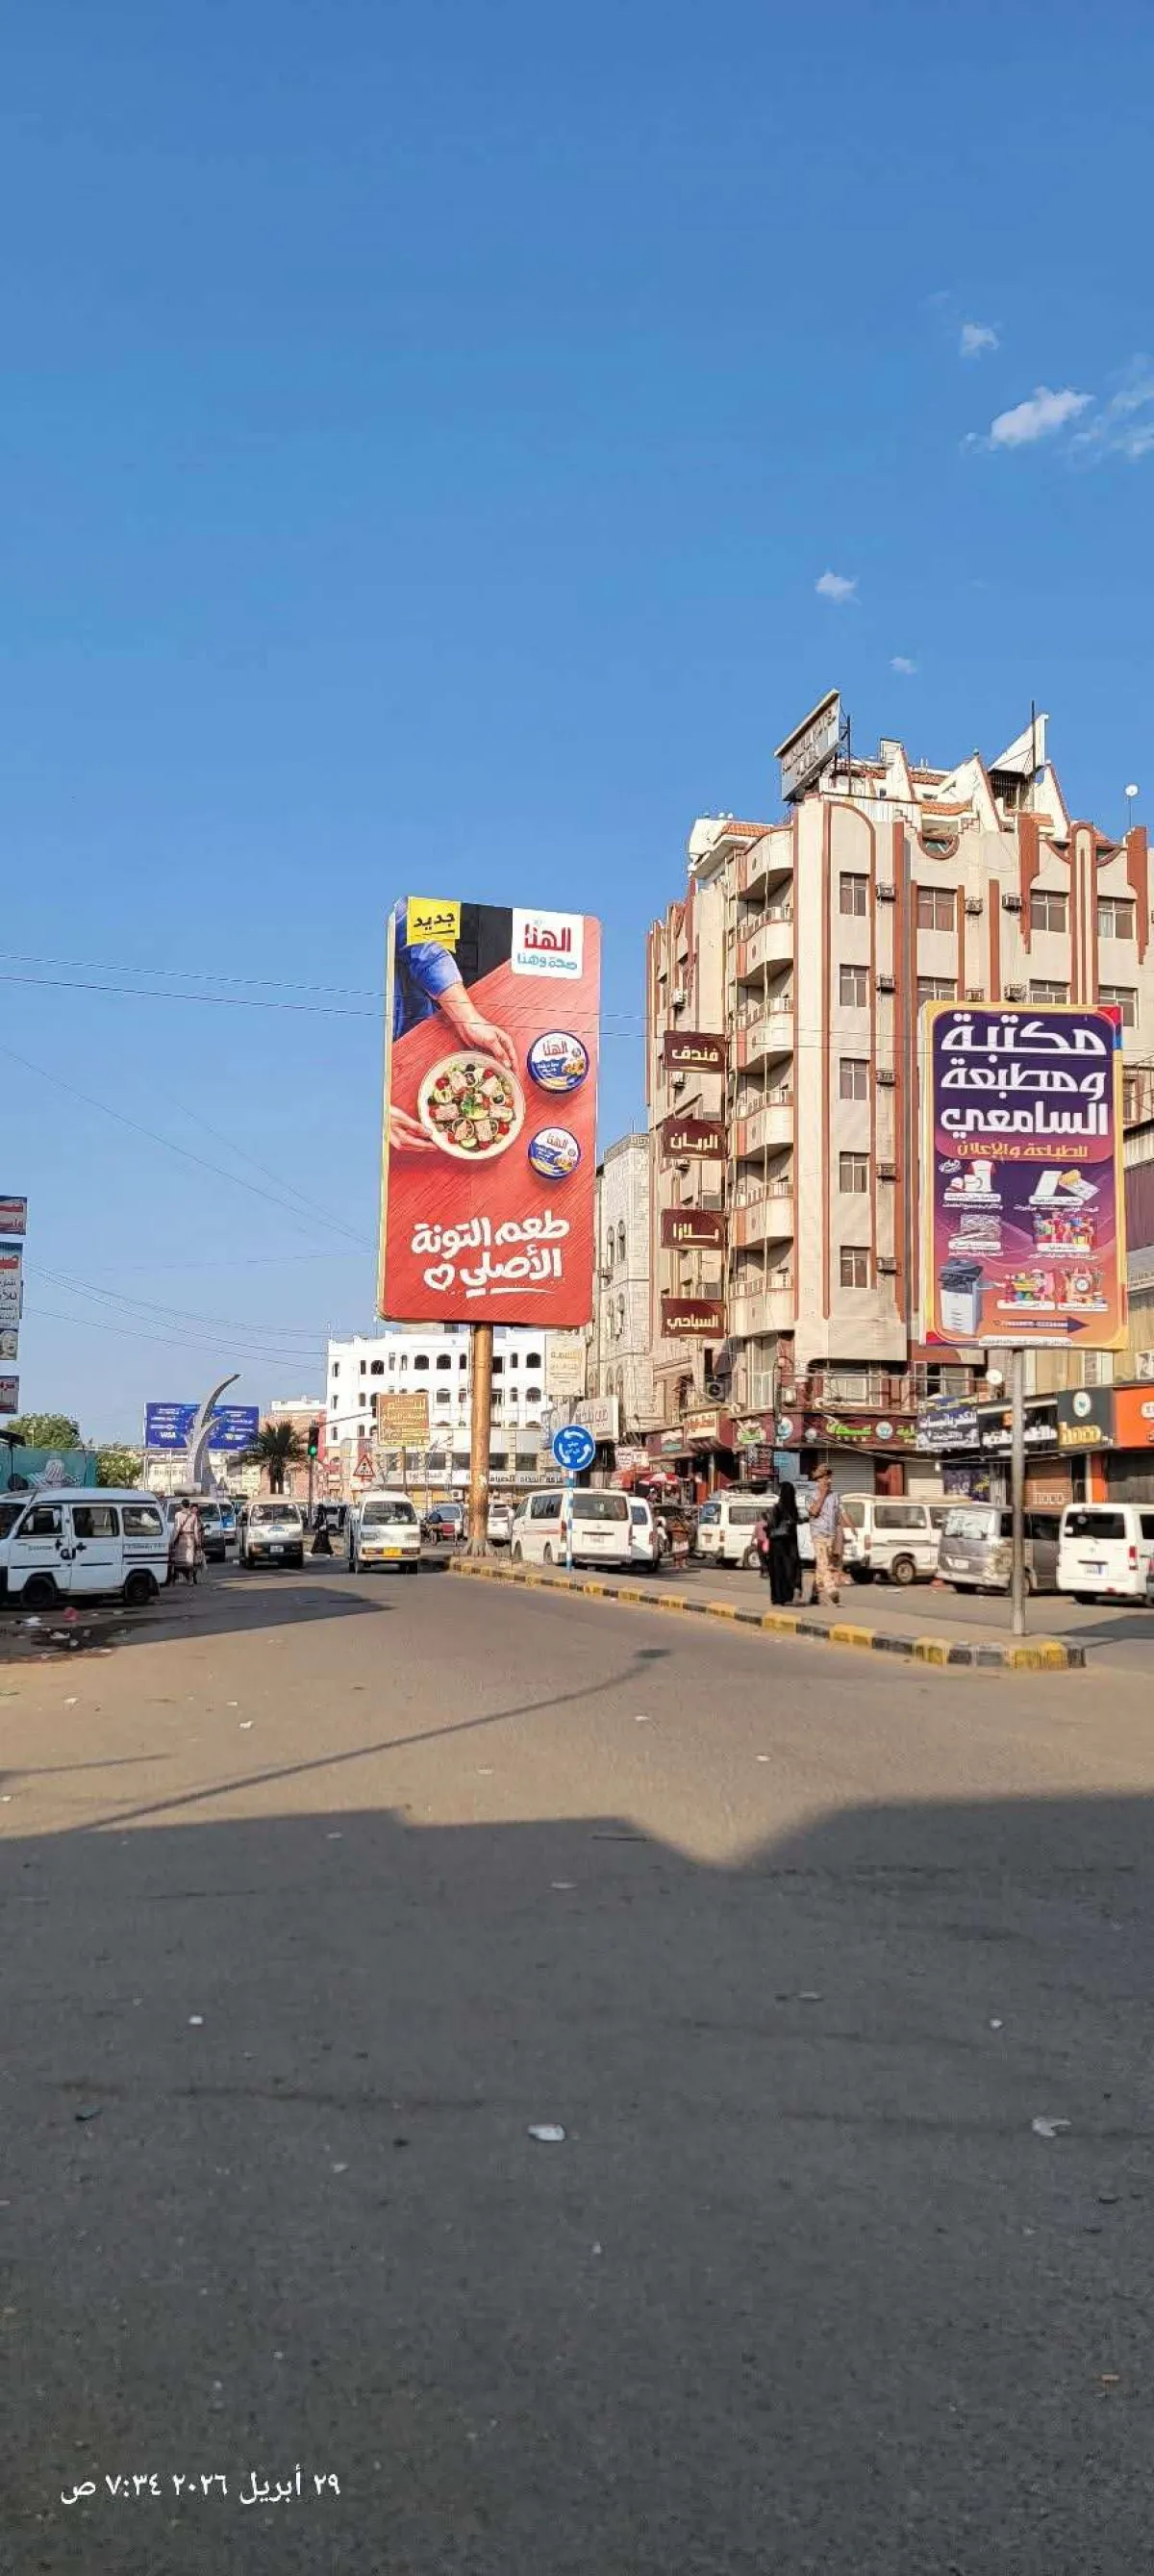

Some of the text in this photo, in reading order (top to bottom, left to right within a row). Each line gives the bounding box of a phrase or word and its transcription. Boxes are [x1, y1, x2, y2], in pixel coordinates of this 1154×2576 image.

[414, 912, 456, 931] جديد
[671, 1047, 718, 1062] فندق
[941, 1014, 1107, 1063] مكتبة
[941, 1057, 1107, 1099] ومطبعة
[941, 1100, 1109, 1139] السامعي
[670, 1132, 718, 1150] الريان
[411, 1208, 570, 1255] طعم التونة
[460, 1248, 562, 1298] الأصلي
[666, 1313, 718, 1329] السياحي
